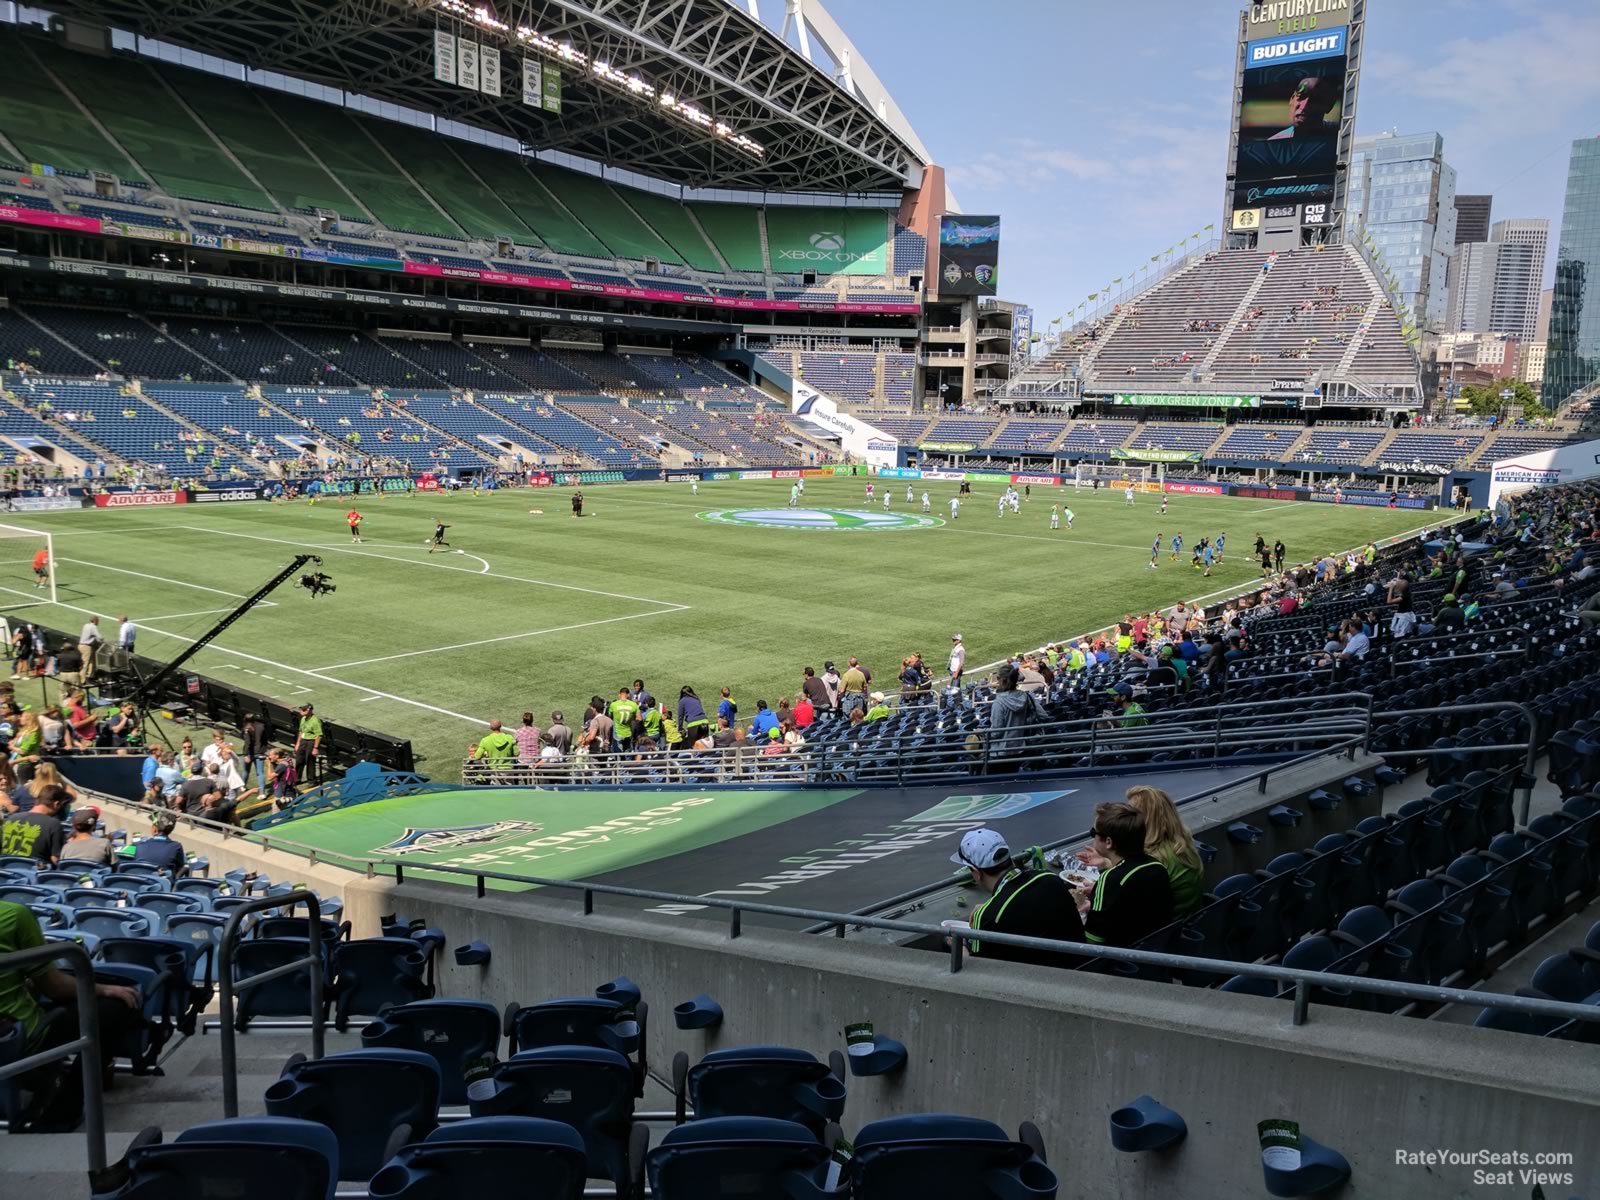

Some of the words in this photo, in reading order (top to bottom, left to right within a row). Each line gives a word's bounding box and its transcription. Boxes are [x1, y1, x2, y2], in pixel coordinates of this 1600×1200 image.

[1278, 16, 1317, 34] FIELD
[1253, 44, 1288, 60] BUD
[1289, 36, 1339, 55] LIGHT
[1263, 184, 1319, 196] BOEING
[1305, 204, 1325, 214] Q13
[1305, 213, 1323, 223] FOX
[195, 235, 218, 247] 22:52
[779, 250, 833, 260] XBOX
[835, 251, 879, 263] ONE
[32, 378, 63, 386] DELTA
[1140, 396, 1165, 404] XBOX
[1167, 397, 1200, 405] GREEN
[1202, 398, 1231, 406] ZONE
[814, 408, 831, 422] Insure
[831, 417, 856, 435] Carefully
[1017, 476, 1054, 484] ADVOCARE
[107, 492, 178, 506] ADVOCARE
[220, 490, 257, 502] adidas
